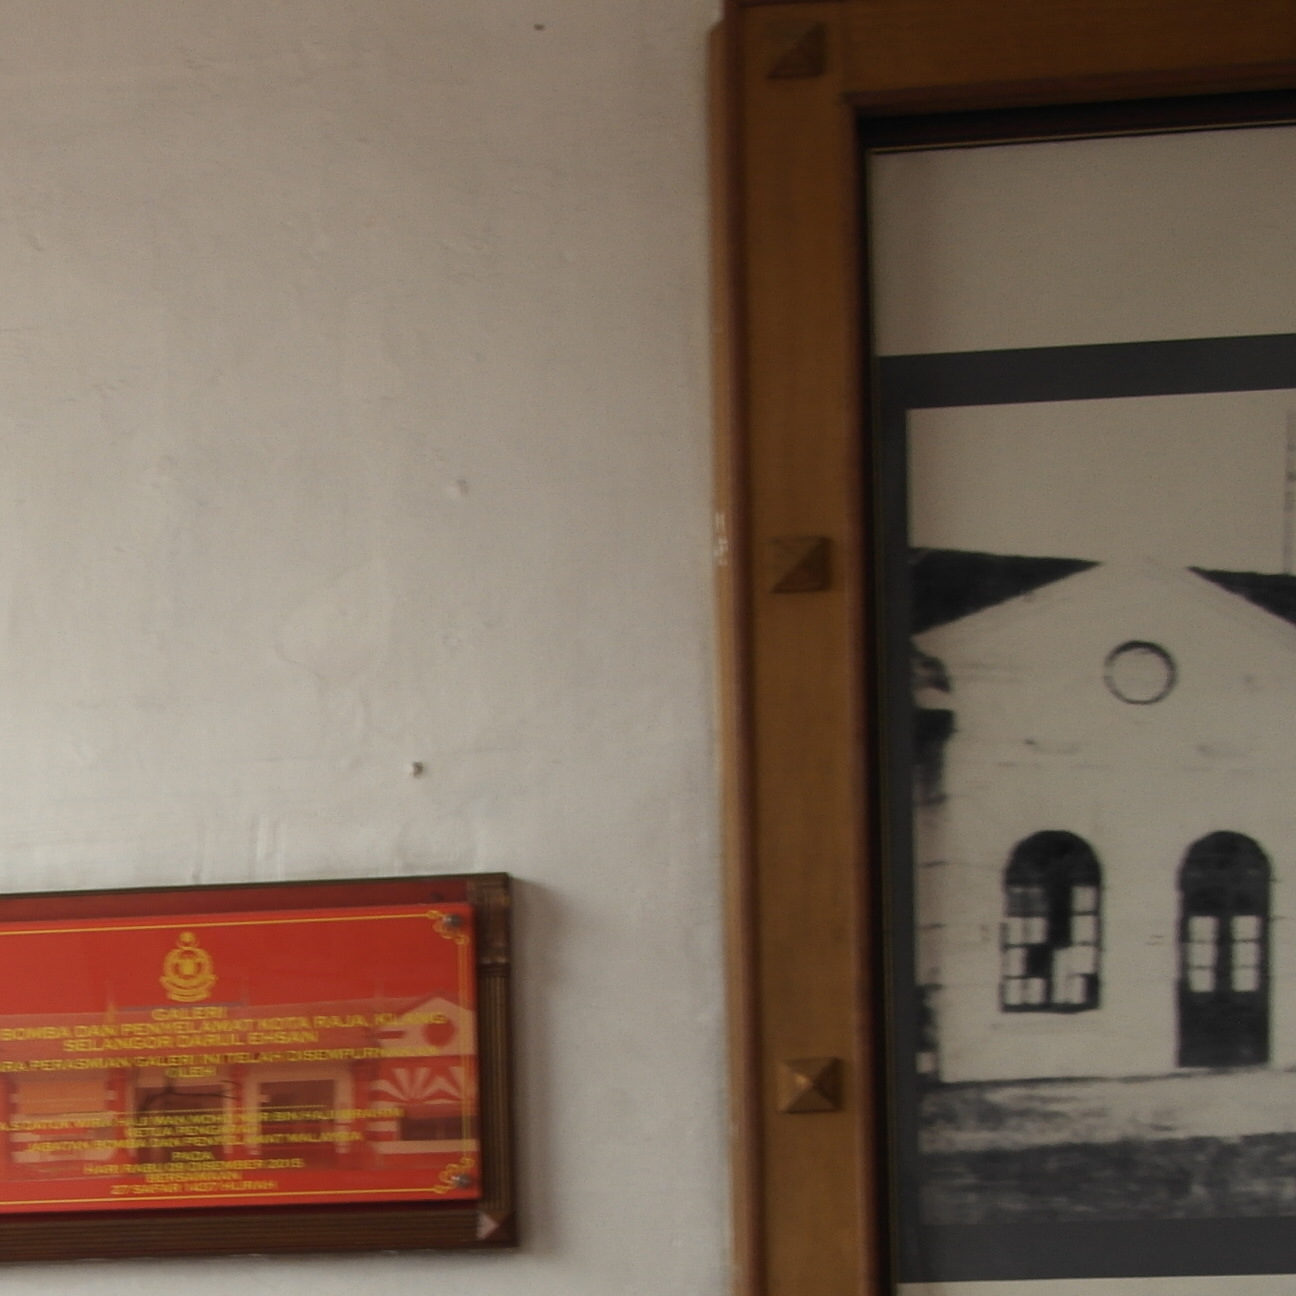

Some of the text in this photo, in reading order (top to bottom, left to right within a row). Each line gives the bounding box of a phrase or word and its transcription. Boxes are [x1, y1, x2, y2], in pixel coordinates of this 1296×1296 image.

[151, 1007, 228, 1020] GALERI
[0, 1026, 70, 1040] BOMBA
[74, 1025, 119, 1037] DAN
[120, 1020, 255, 1035] PENYELAMAT
[257, 1018, 309, 1030] KOTA
[63, 1031, 319, 1051] SELANGOR DARUL EHSAN
[133, 1055, 195, 1067] GALERI
[164, 1067, 216, 1078] OLEH
